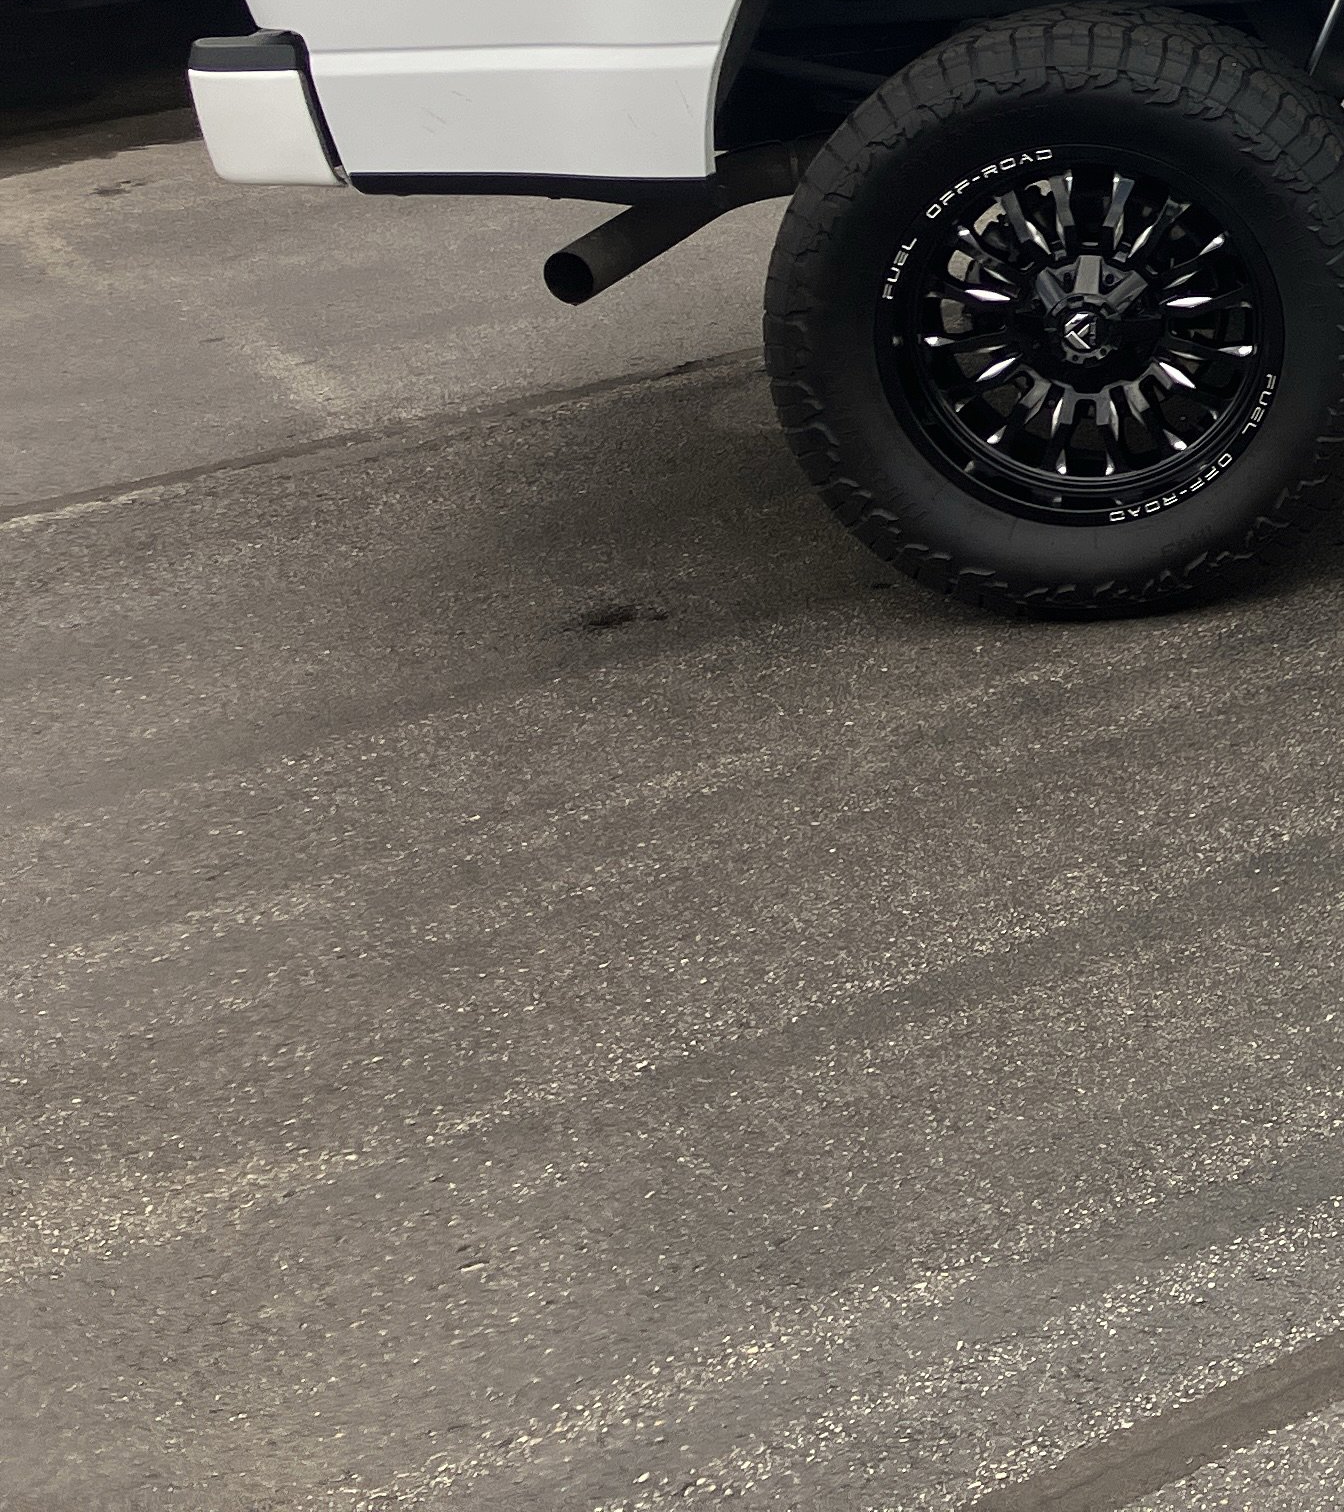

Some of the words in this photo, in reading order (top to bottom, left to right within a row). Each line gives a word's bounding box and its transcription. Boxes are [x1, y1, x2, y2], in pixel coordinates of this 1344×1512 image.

[880, 236, 918, 302] FUEL
[925, 147, 1054, 221] OFF-ROAD
[1240, 371, 1277, 437] FUEL
[1108, 451, 1234, 524] OFF-ROAD
